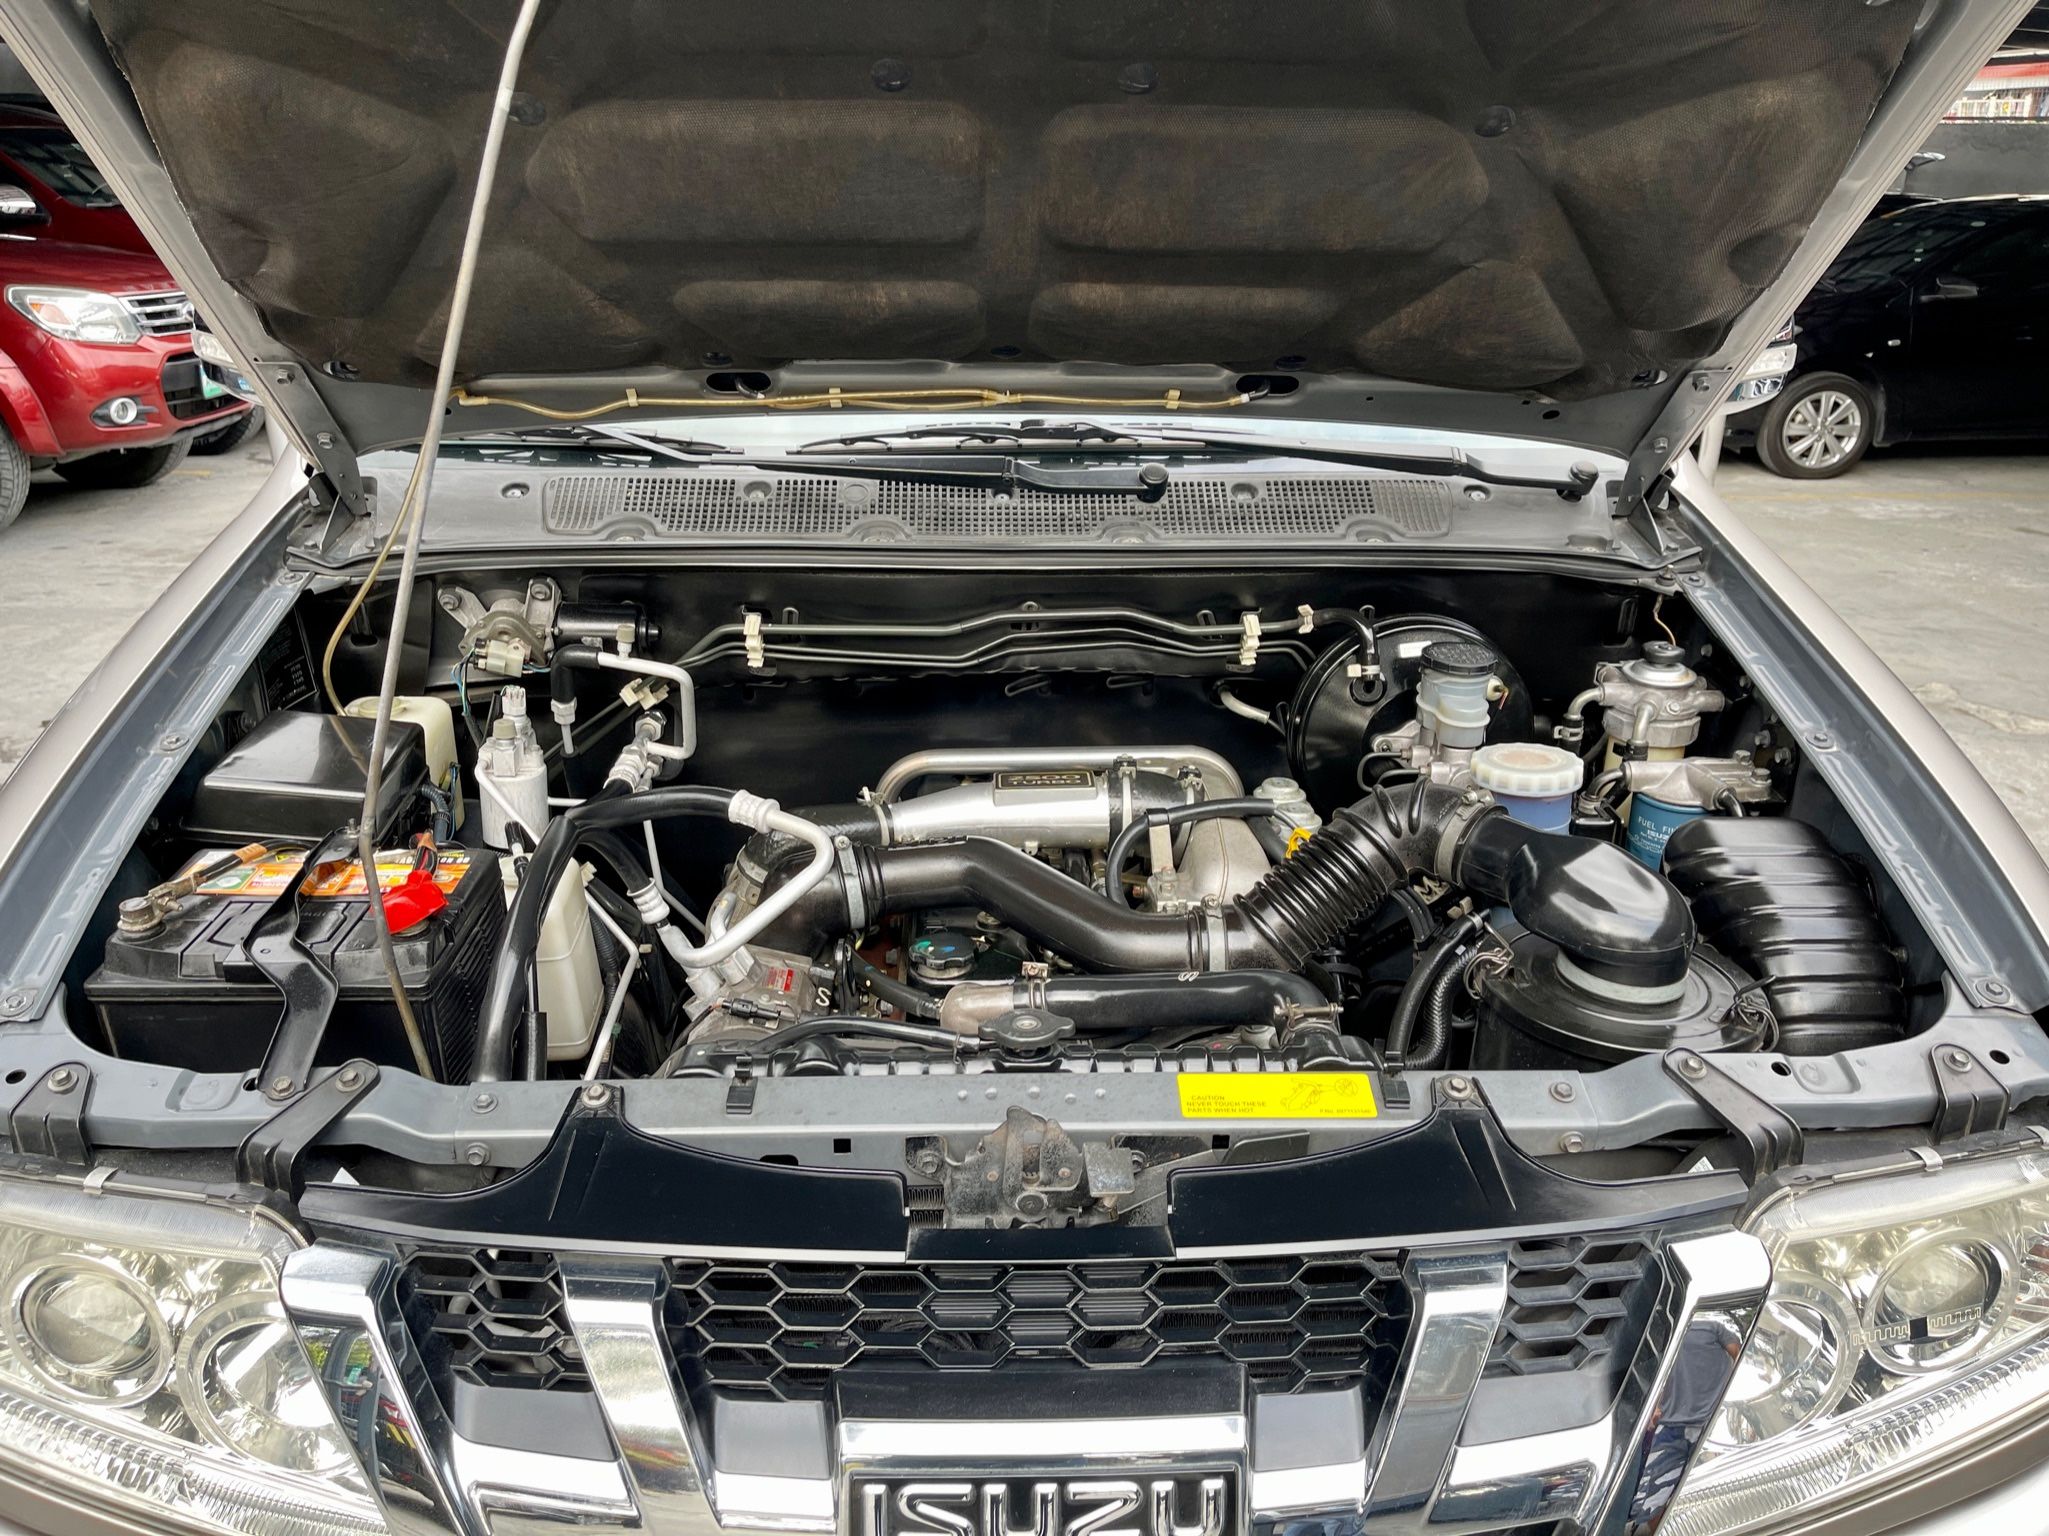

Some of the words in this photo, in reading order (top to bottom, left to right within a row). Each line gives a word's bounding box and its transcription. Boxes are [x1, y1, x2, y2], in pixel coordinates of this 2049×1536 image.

[1639, 816, 1656, 830] FUEL
[1647, 828, 1669, 840] ISUZ
[815, 986, 832, 1007] S
[860, 1480, 1227, 1536] ISUZU
